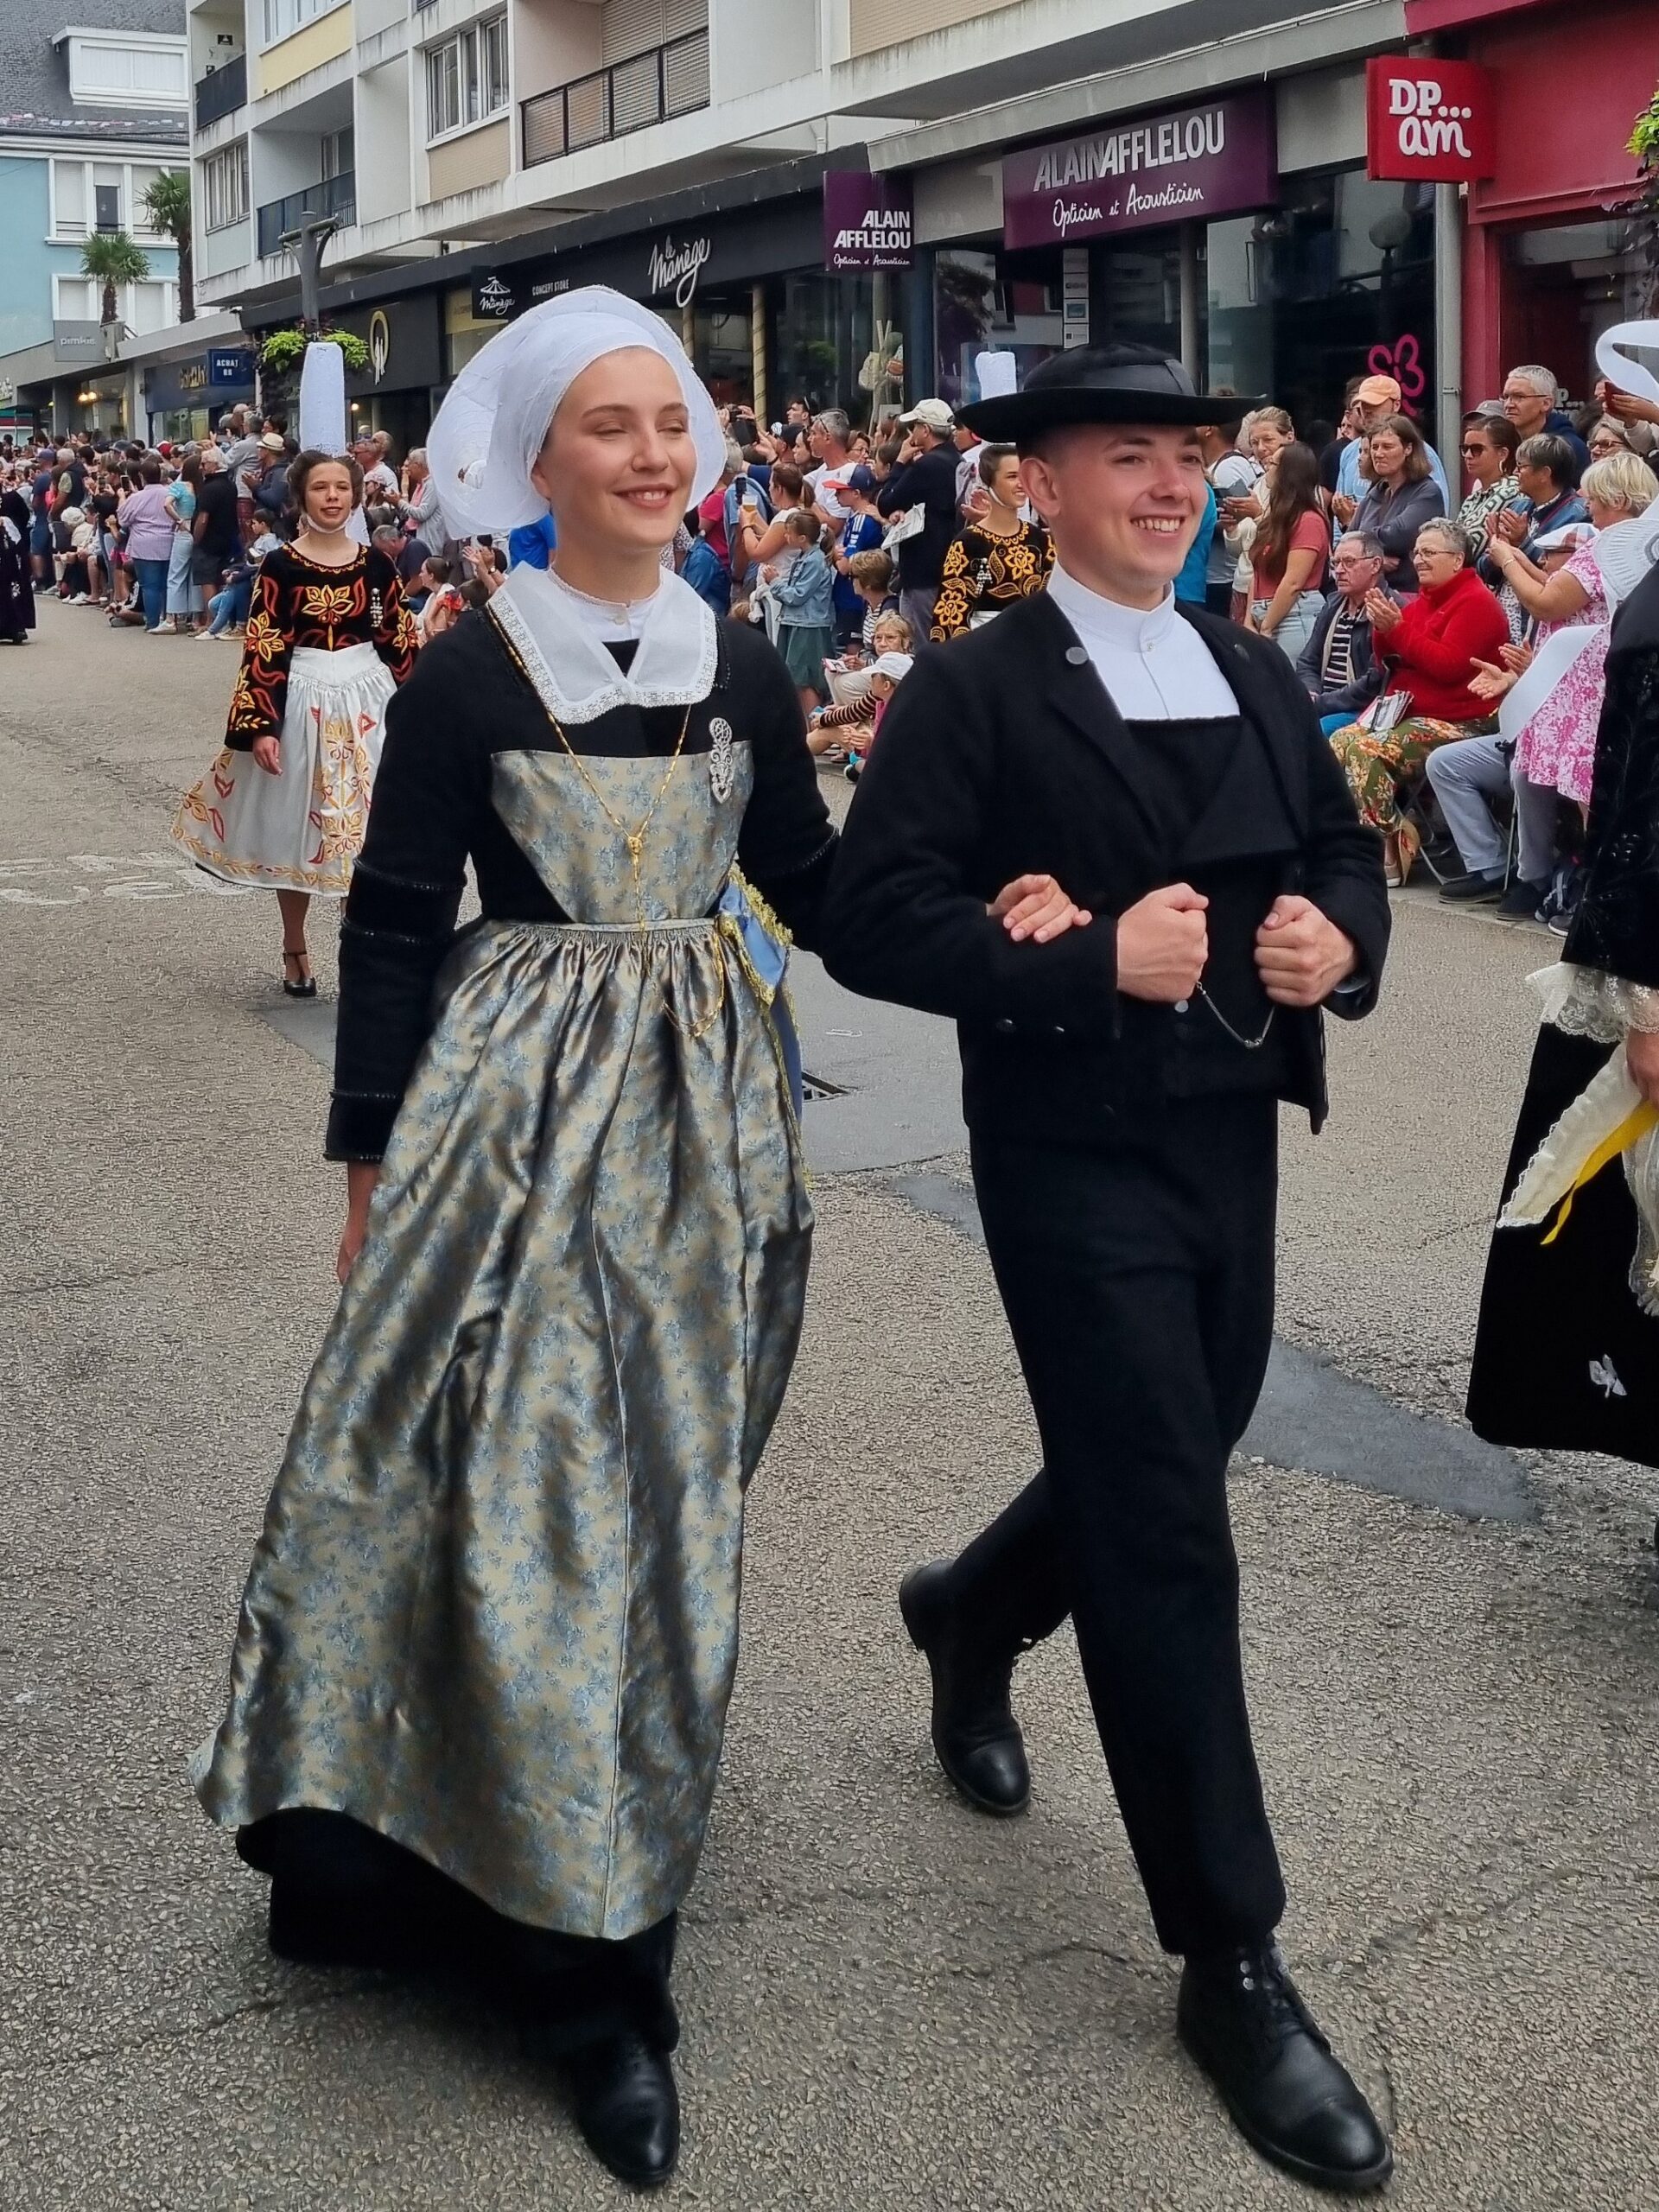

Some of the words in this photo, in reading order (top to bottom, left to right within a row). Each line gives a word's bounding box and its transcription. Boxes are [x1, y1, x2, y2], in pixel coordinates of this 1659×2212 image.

[1033, 140, 1105, 192] ALAIN
[1099, 111, 1224, 177] AFFLELOU
[1399, 116, 1471, 158] am
[861, 210, 911, 228] ALAIN
[1052, 198, 1103, 238] Opticien
[1109, 200, 1120, 216] et
[1126, 182, 1204, 215] Acousticien
[833, 230, 911, 249] AFFLELOU
[648, 238, 710, 308] Manège
[834, 253, 861, 269] Opticien
[873, 254, 911, 266] Acousticien
[531, 281, 554, 296] CONCEPT
[554, 278, 569, 292] STORE
